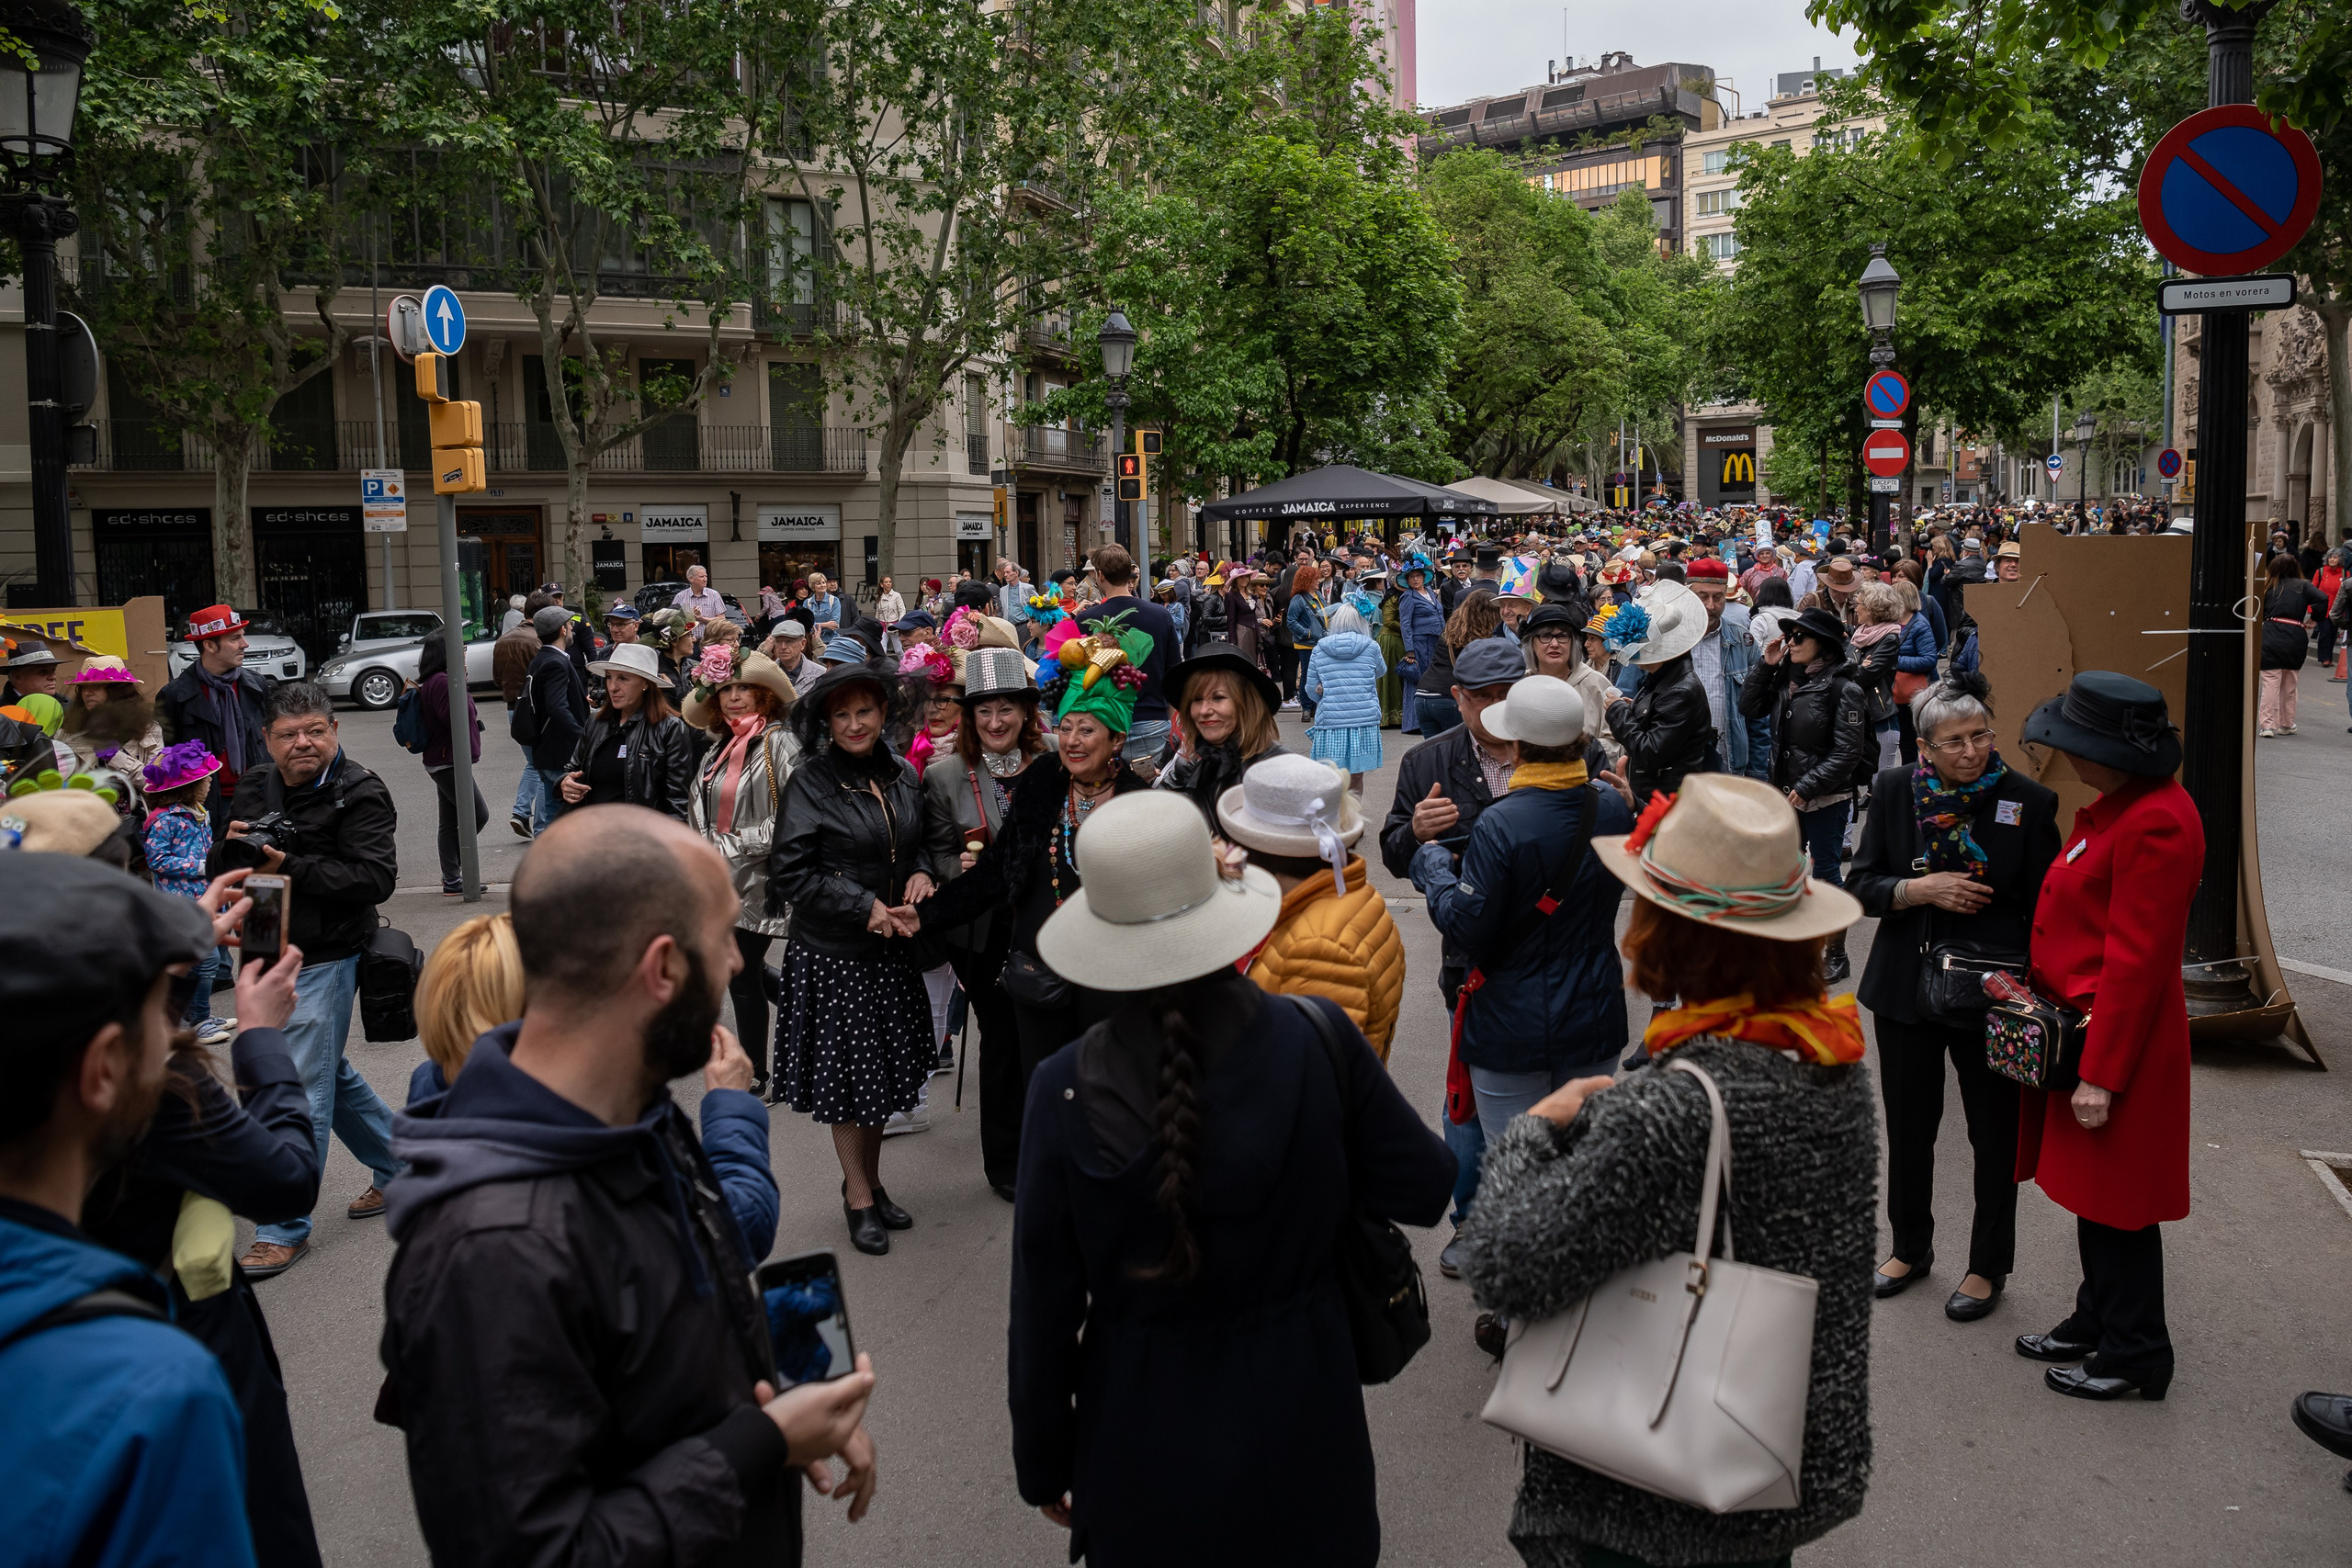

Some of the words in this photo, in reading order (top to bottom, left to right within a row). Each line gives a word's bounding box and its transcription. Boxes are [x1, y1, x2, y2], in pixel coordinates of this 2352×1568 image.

[2184, 291, 2216, 299] Motos
[2235, 288, 2269, 296] vorera
[1705, 434, 1749, 443] McDonald's
[368, 481, 379, 495] P
[1282, 502, 1336, 514] JAMAICA
[645, 517, 703, 527] JAMAICA
[772, 516, 825, 526] JAMAICA
